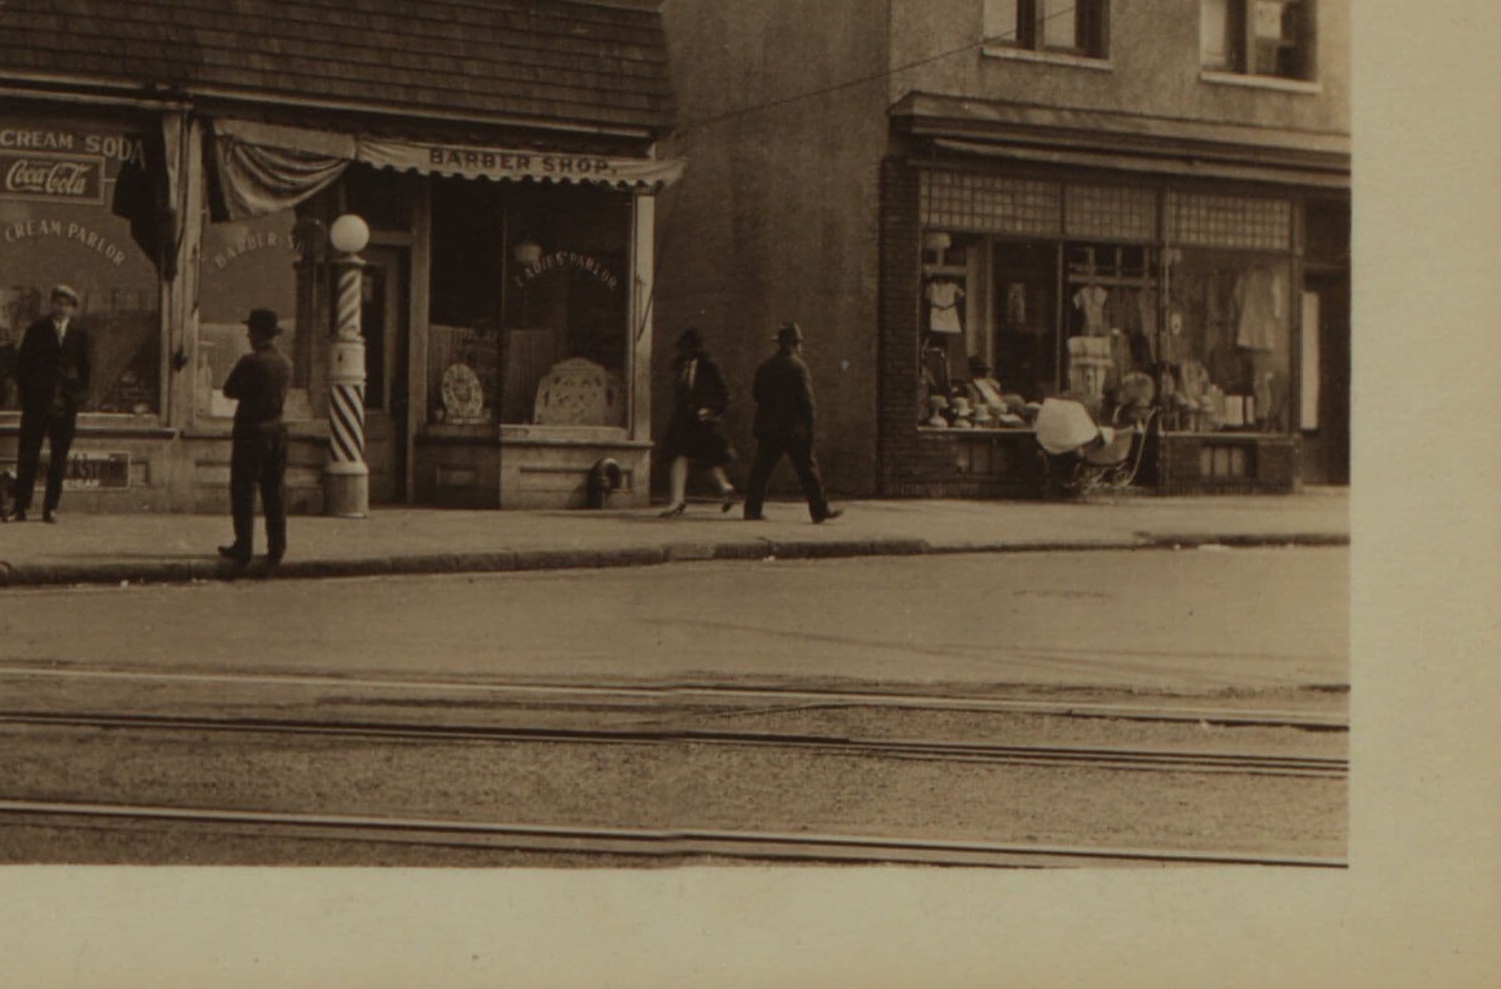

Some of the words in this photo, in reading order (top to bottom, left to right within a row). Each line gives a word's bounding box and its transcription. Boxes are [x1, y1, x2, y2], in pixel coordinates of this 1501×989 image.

[85, 134, 147, 171] SODA
[429, 147, 531, 170] BARBER
[4, 218, 62, 243] CREAM
[66, 222, 126, 267] PARLOR
